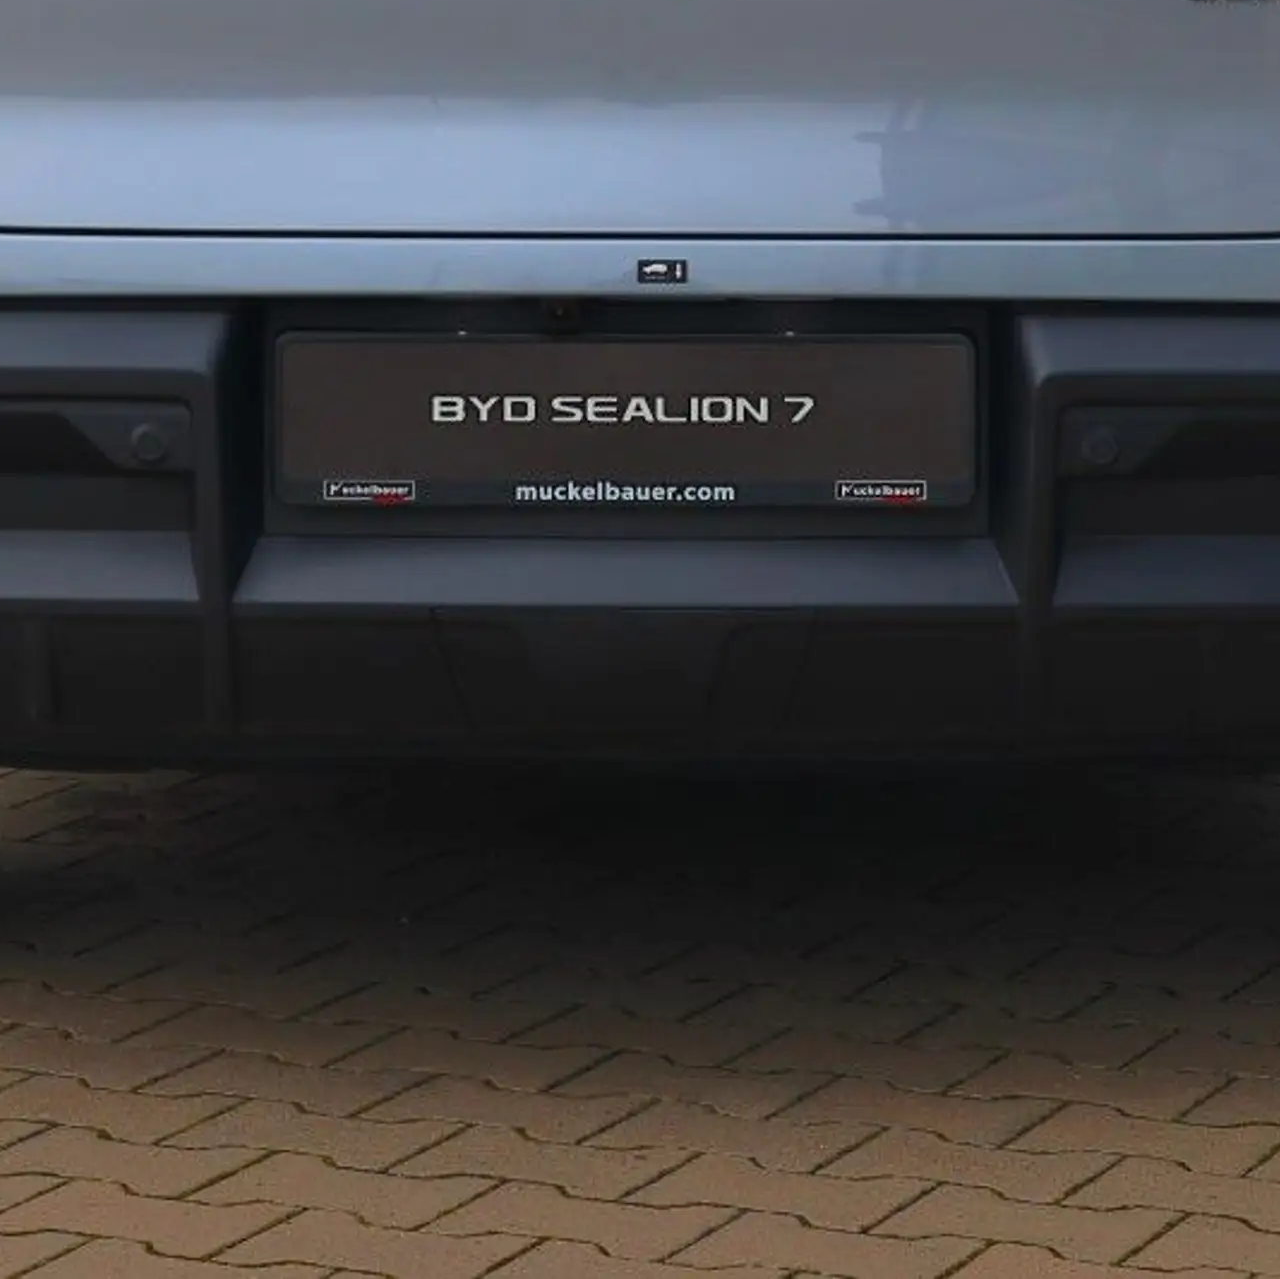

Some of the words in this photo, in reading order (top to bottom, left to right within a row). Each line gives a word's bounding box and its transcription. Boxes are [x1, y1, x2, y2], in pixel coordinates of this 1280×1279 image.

[431, 396, 535, 423] BYD
[551, 395, 769, 423] SEALION
[785, 396, 815, 423] 7
[515, 481, 735, 502] muckelbauer.com
